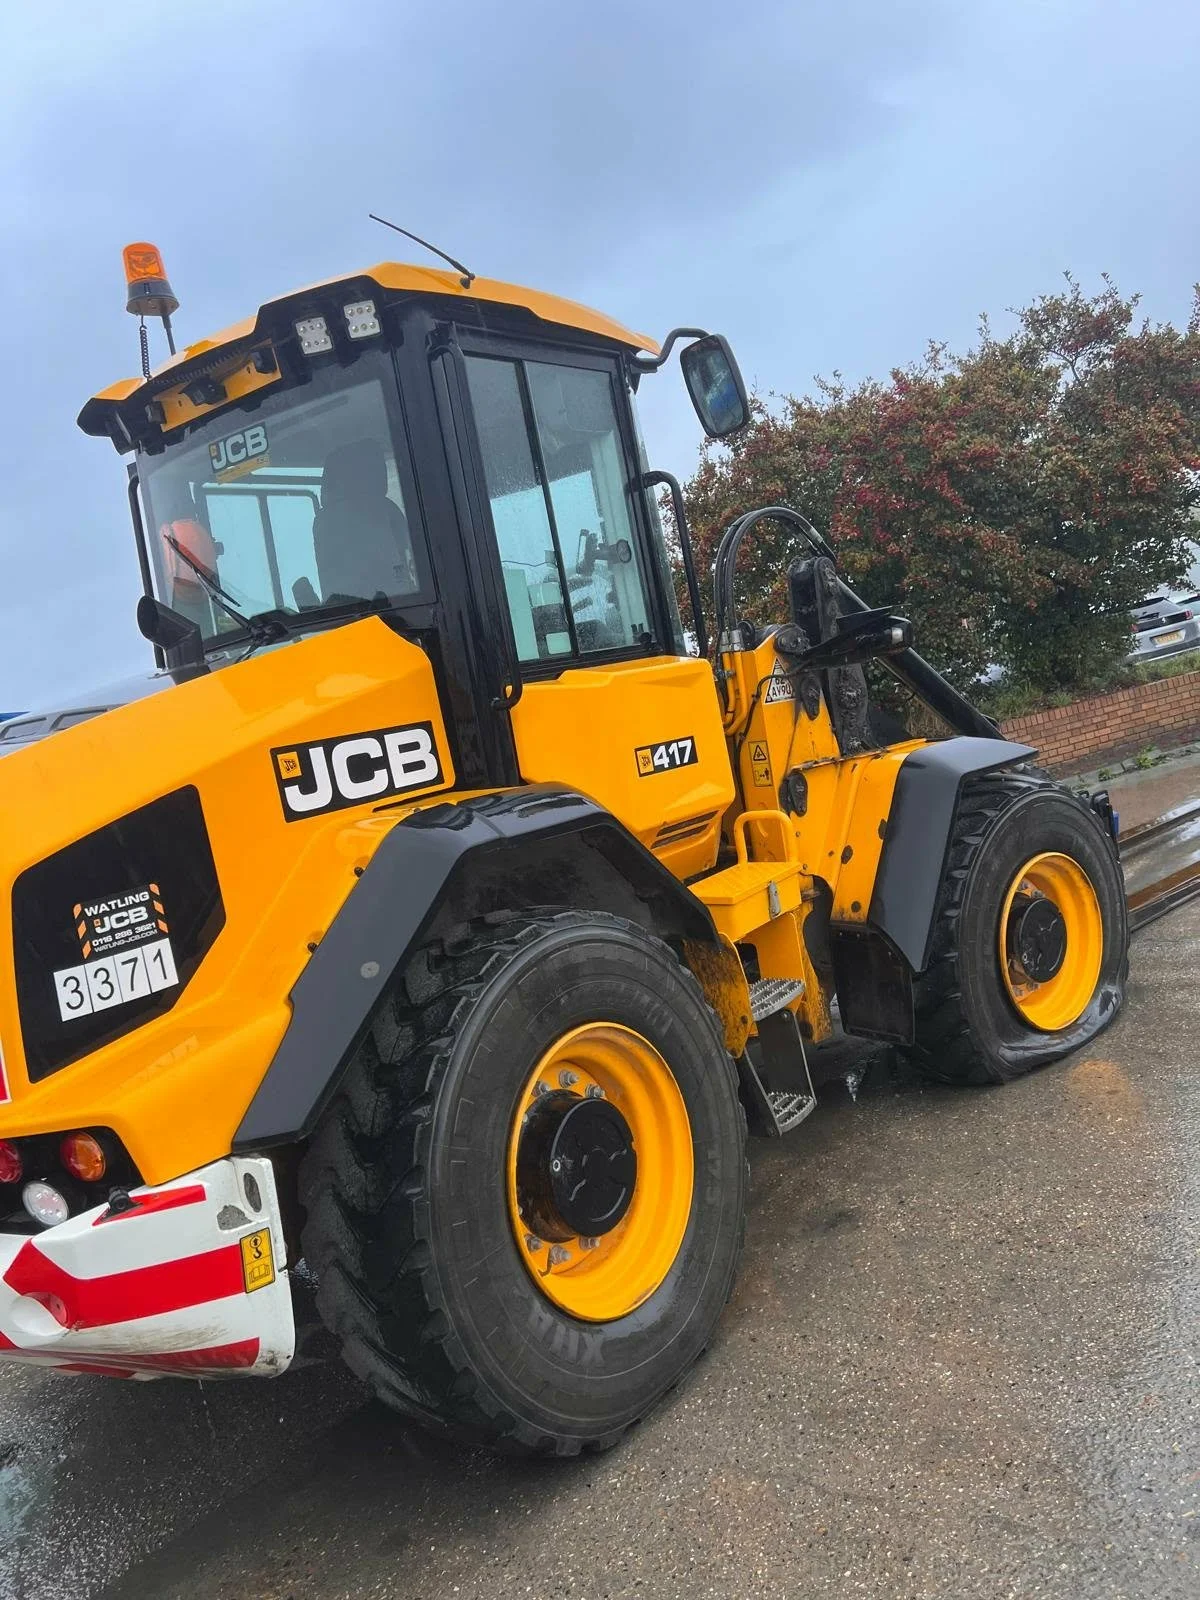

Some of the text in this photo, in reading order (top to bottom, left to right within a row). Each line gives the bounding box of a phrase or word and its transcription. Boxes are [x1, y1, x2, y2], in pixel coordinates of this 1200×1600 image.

[212, 426, 267, 470] JCB
[284, 728, 439, 812] JCB
[653, 739, 692, 768] 417
[84, 891, 150, 917] WATLING
[95, 906, 148, 934] JCB
[63, 948, 167, 1010] 3371
